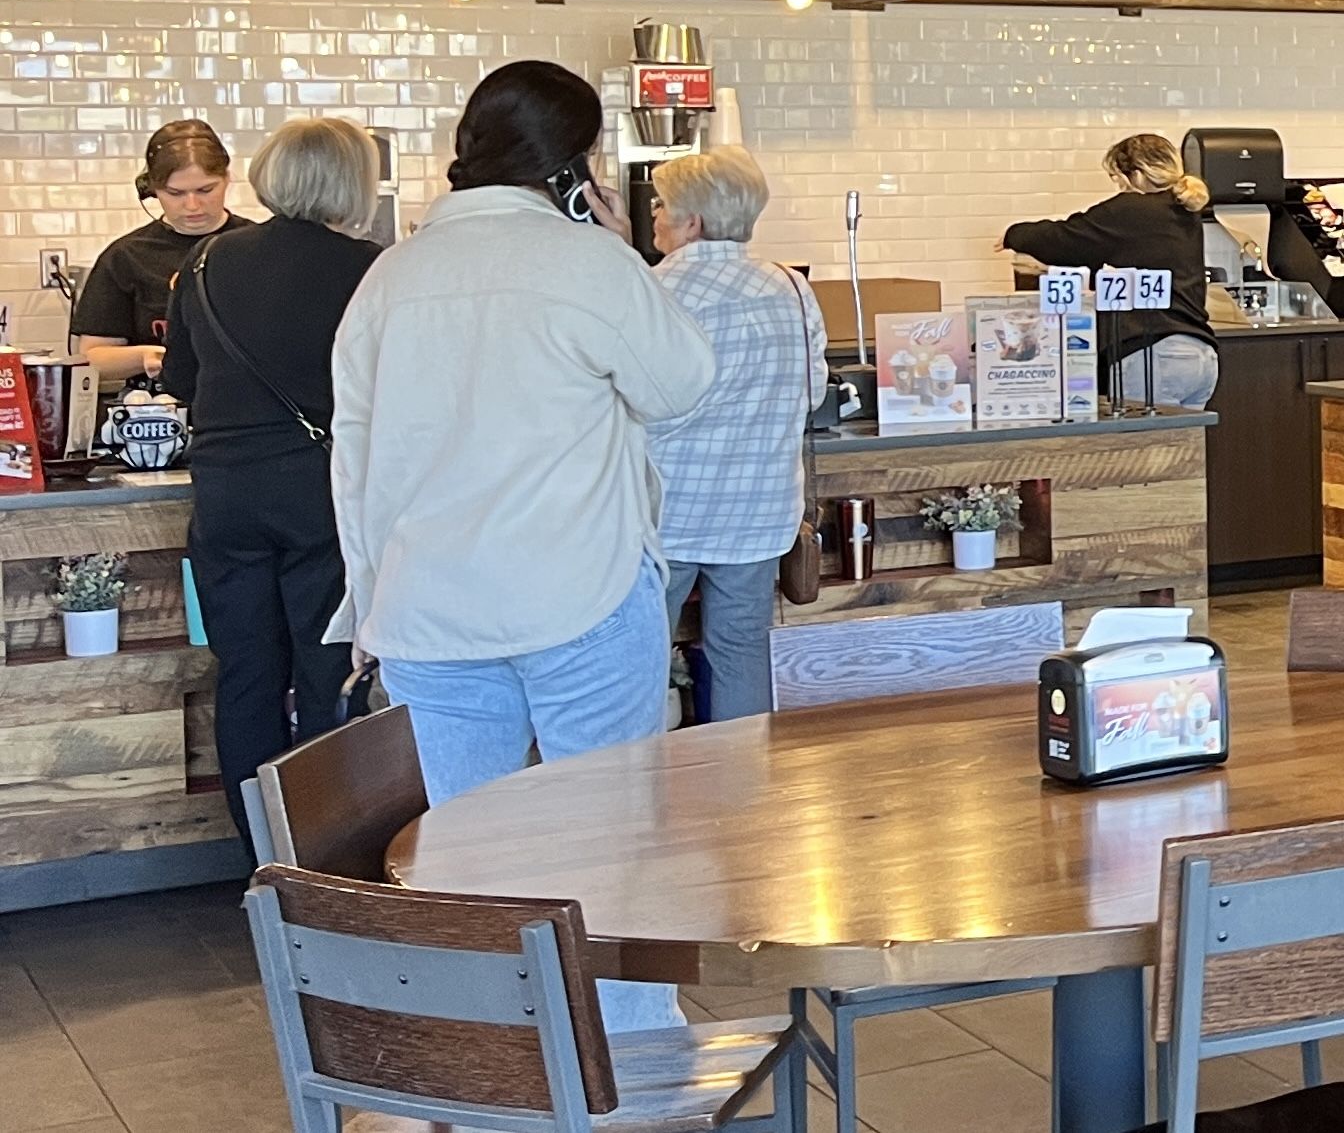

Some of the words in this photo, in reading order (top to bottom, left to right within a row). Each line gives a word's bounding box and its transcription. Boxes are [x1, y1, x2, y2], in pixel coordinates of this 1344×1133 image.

[666, 73, 707, 83] COFFEE
[1047, 280, 1074, 304] 53
[1102, 277, 1126, 300] 72
[1140, 275, 1164, 298] 54
[909, 317, 952, 342] Fall
[122, 422, 175, 438] COFFEE
[1101, 711, 1151, 746] Fall
